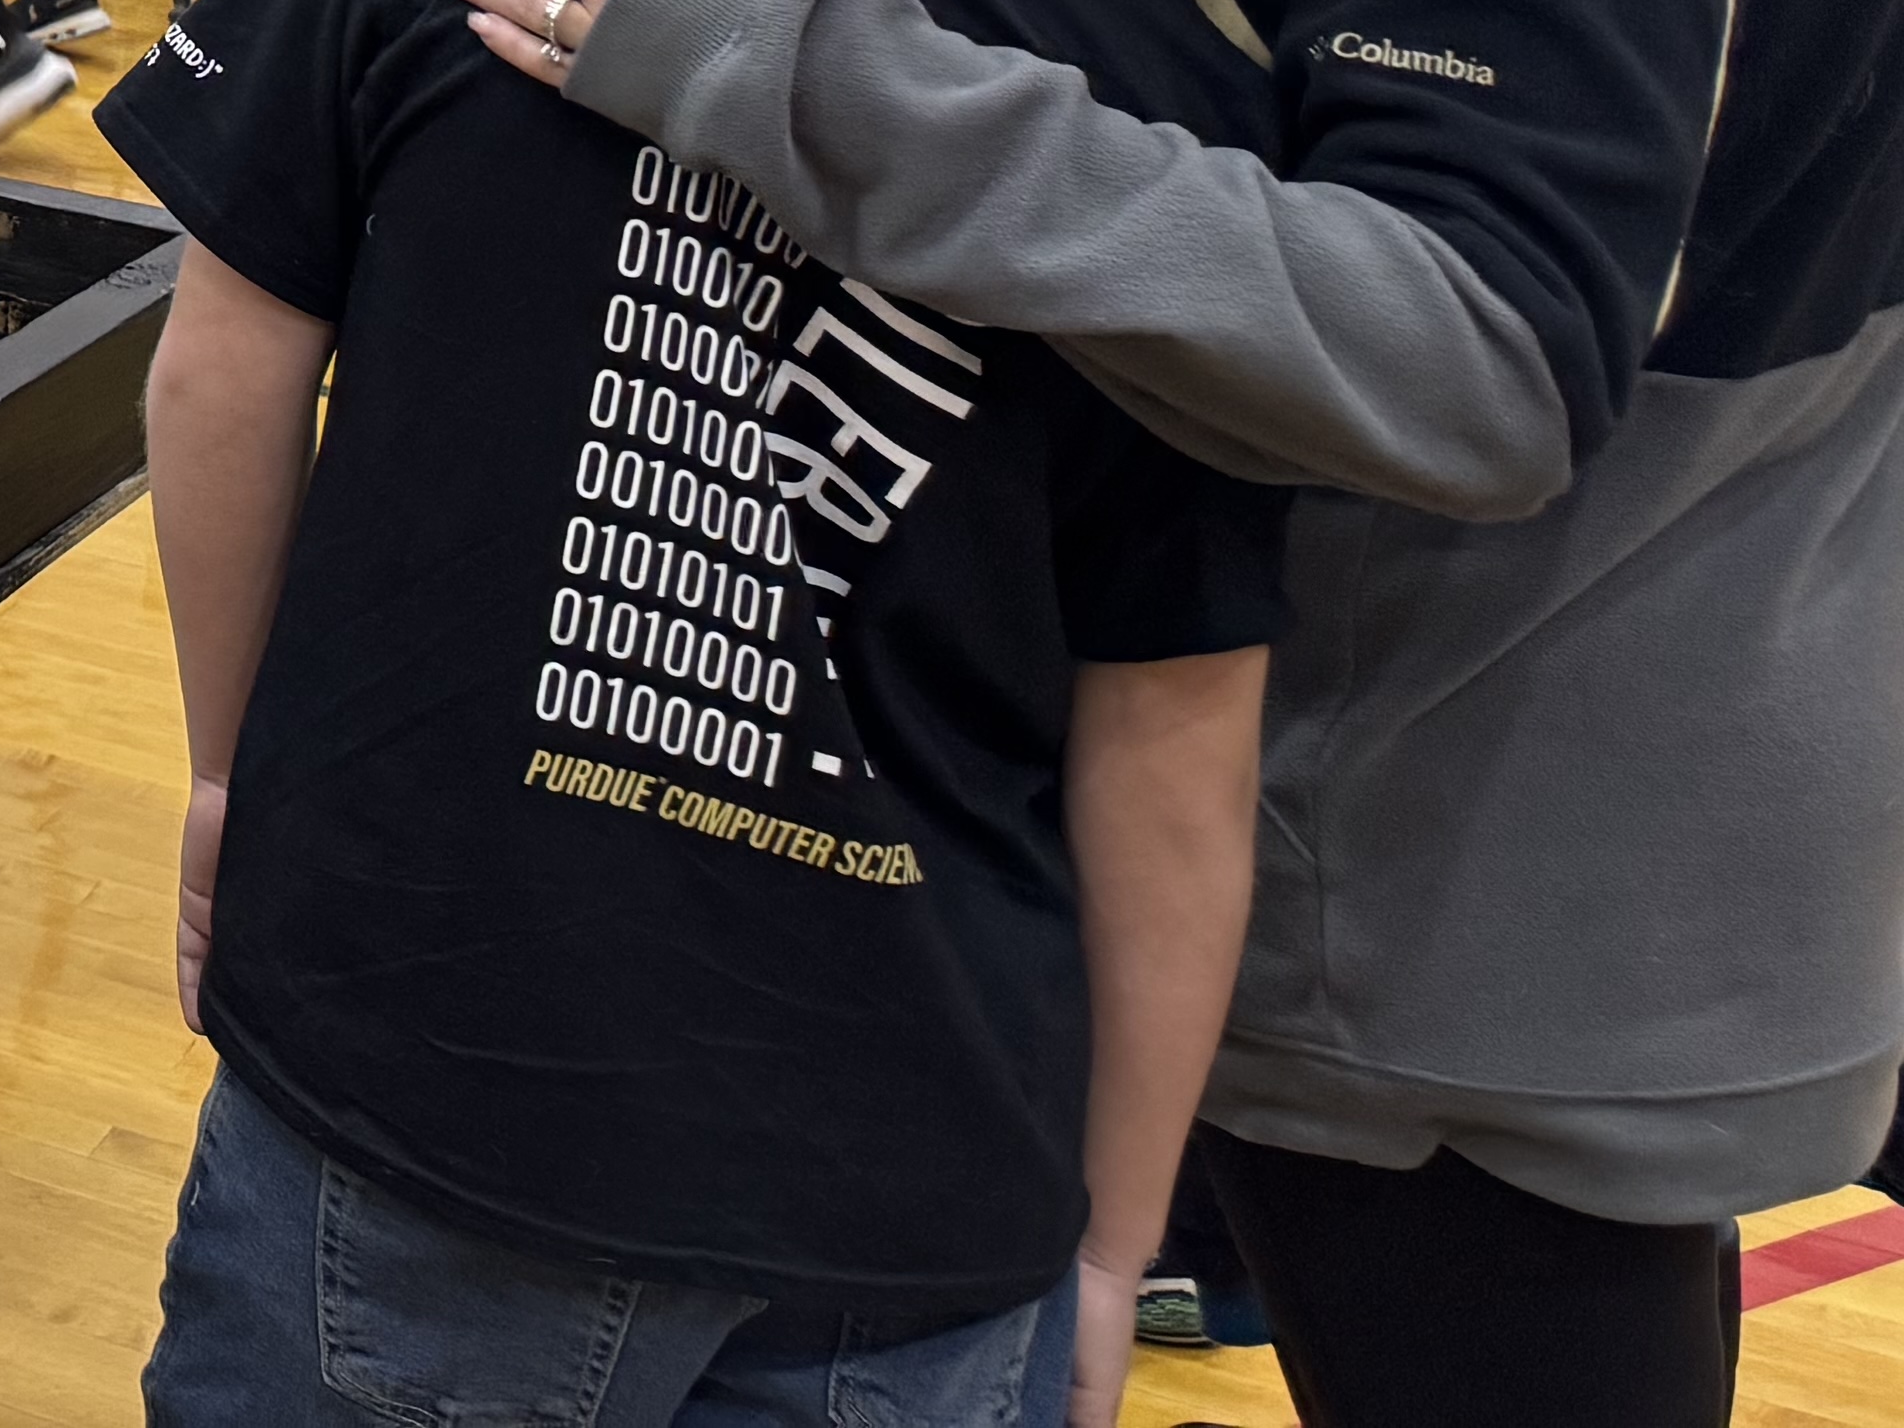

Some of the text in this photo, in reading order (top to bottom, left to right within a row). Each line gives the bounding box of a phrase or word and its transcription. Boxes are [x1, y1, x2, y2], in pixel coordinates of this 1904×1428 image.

[1332, 31, 1496, 86] Columbia
[562, 516, 784, 641] 01010101
[549, 587, 796, 716] 01010000
[535, 662, 785, 788] 00100001
[523, 749, 654, 812] PURDUE
[658, 784, 837, 868] COMPUTER
